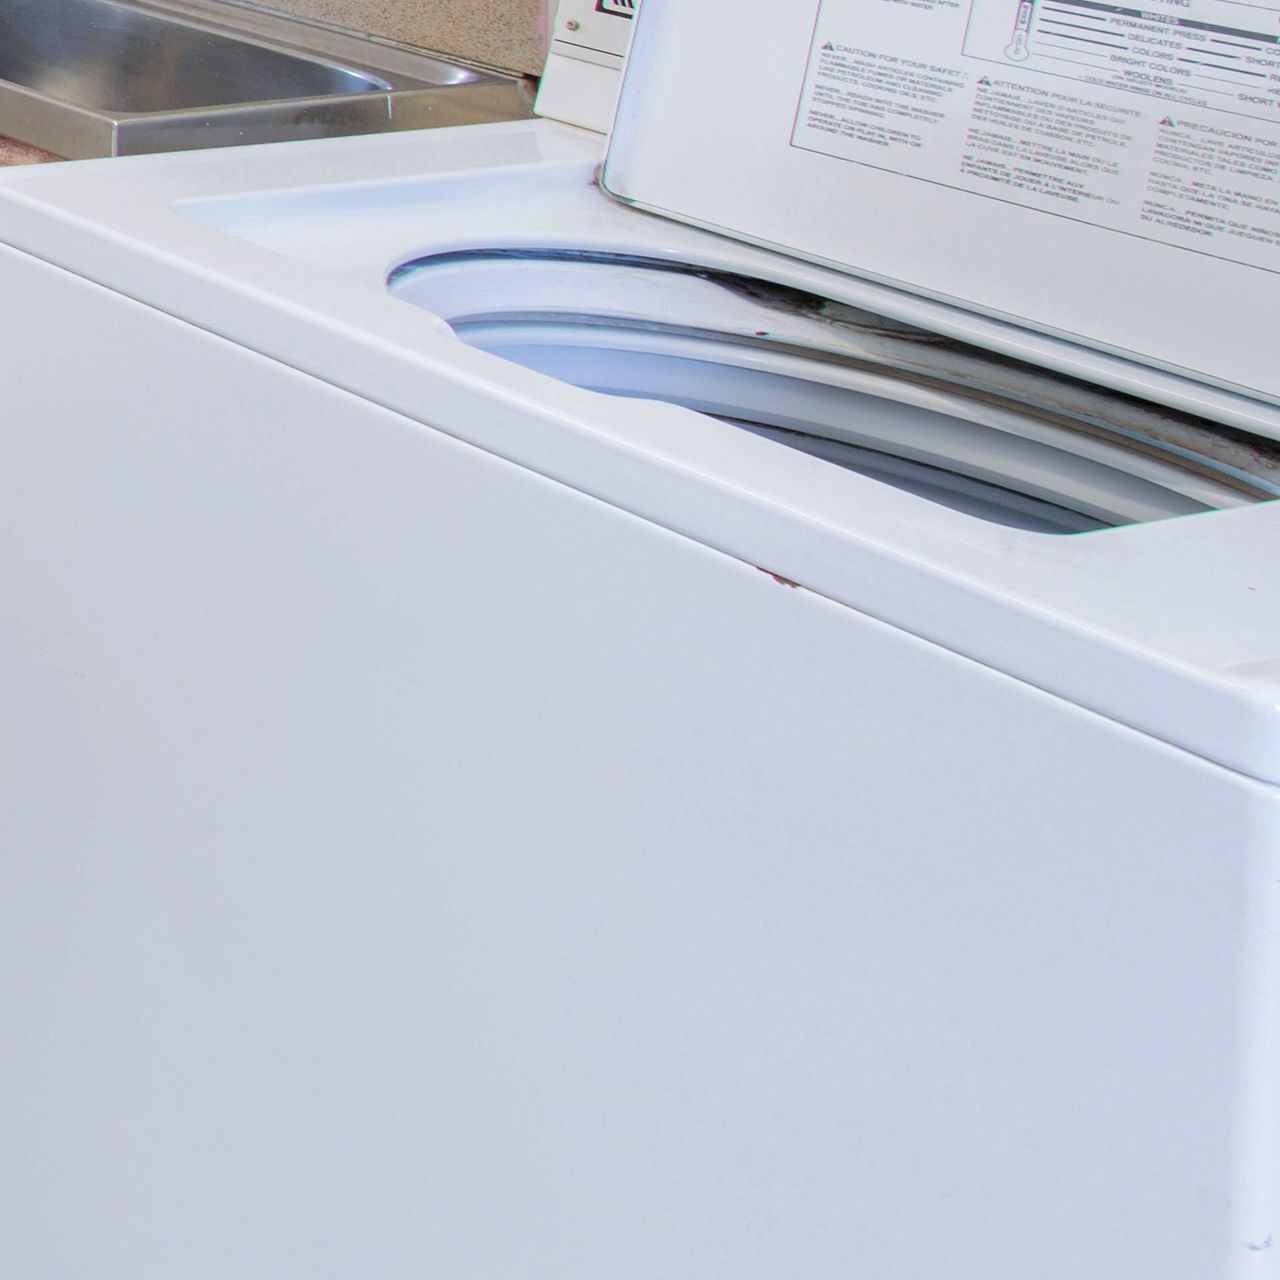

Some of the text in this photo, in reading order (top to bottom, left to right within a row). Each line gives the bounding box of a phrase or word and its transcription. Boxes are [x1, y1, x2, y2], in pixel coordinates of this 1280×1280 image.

[1107, 17, 1207, 42] PERMANENT PRESS
[1126, 32, 1182, 49] DELICATES
[834, 44, 876, 58] CAUTION
[877, 53, 898, 63] FOR
[898, 58, 927, 70] YOUR
[1130, 46, 1174, 60] COLORS
[1109, 54, 1192, 77] BRIGHT COLORS
[1122, 69, 1173, 86] WOOLENS
[992, 79, 1093, 106] ATTENTION POUR LA
